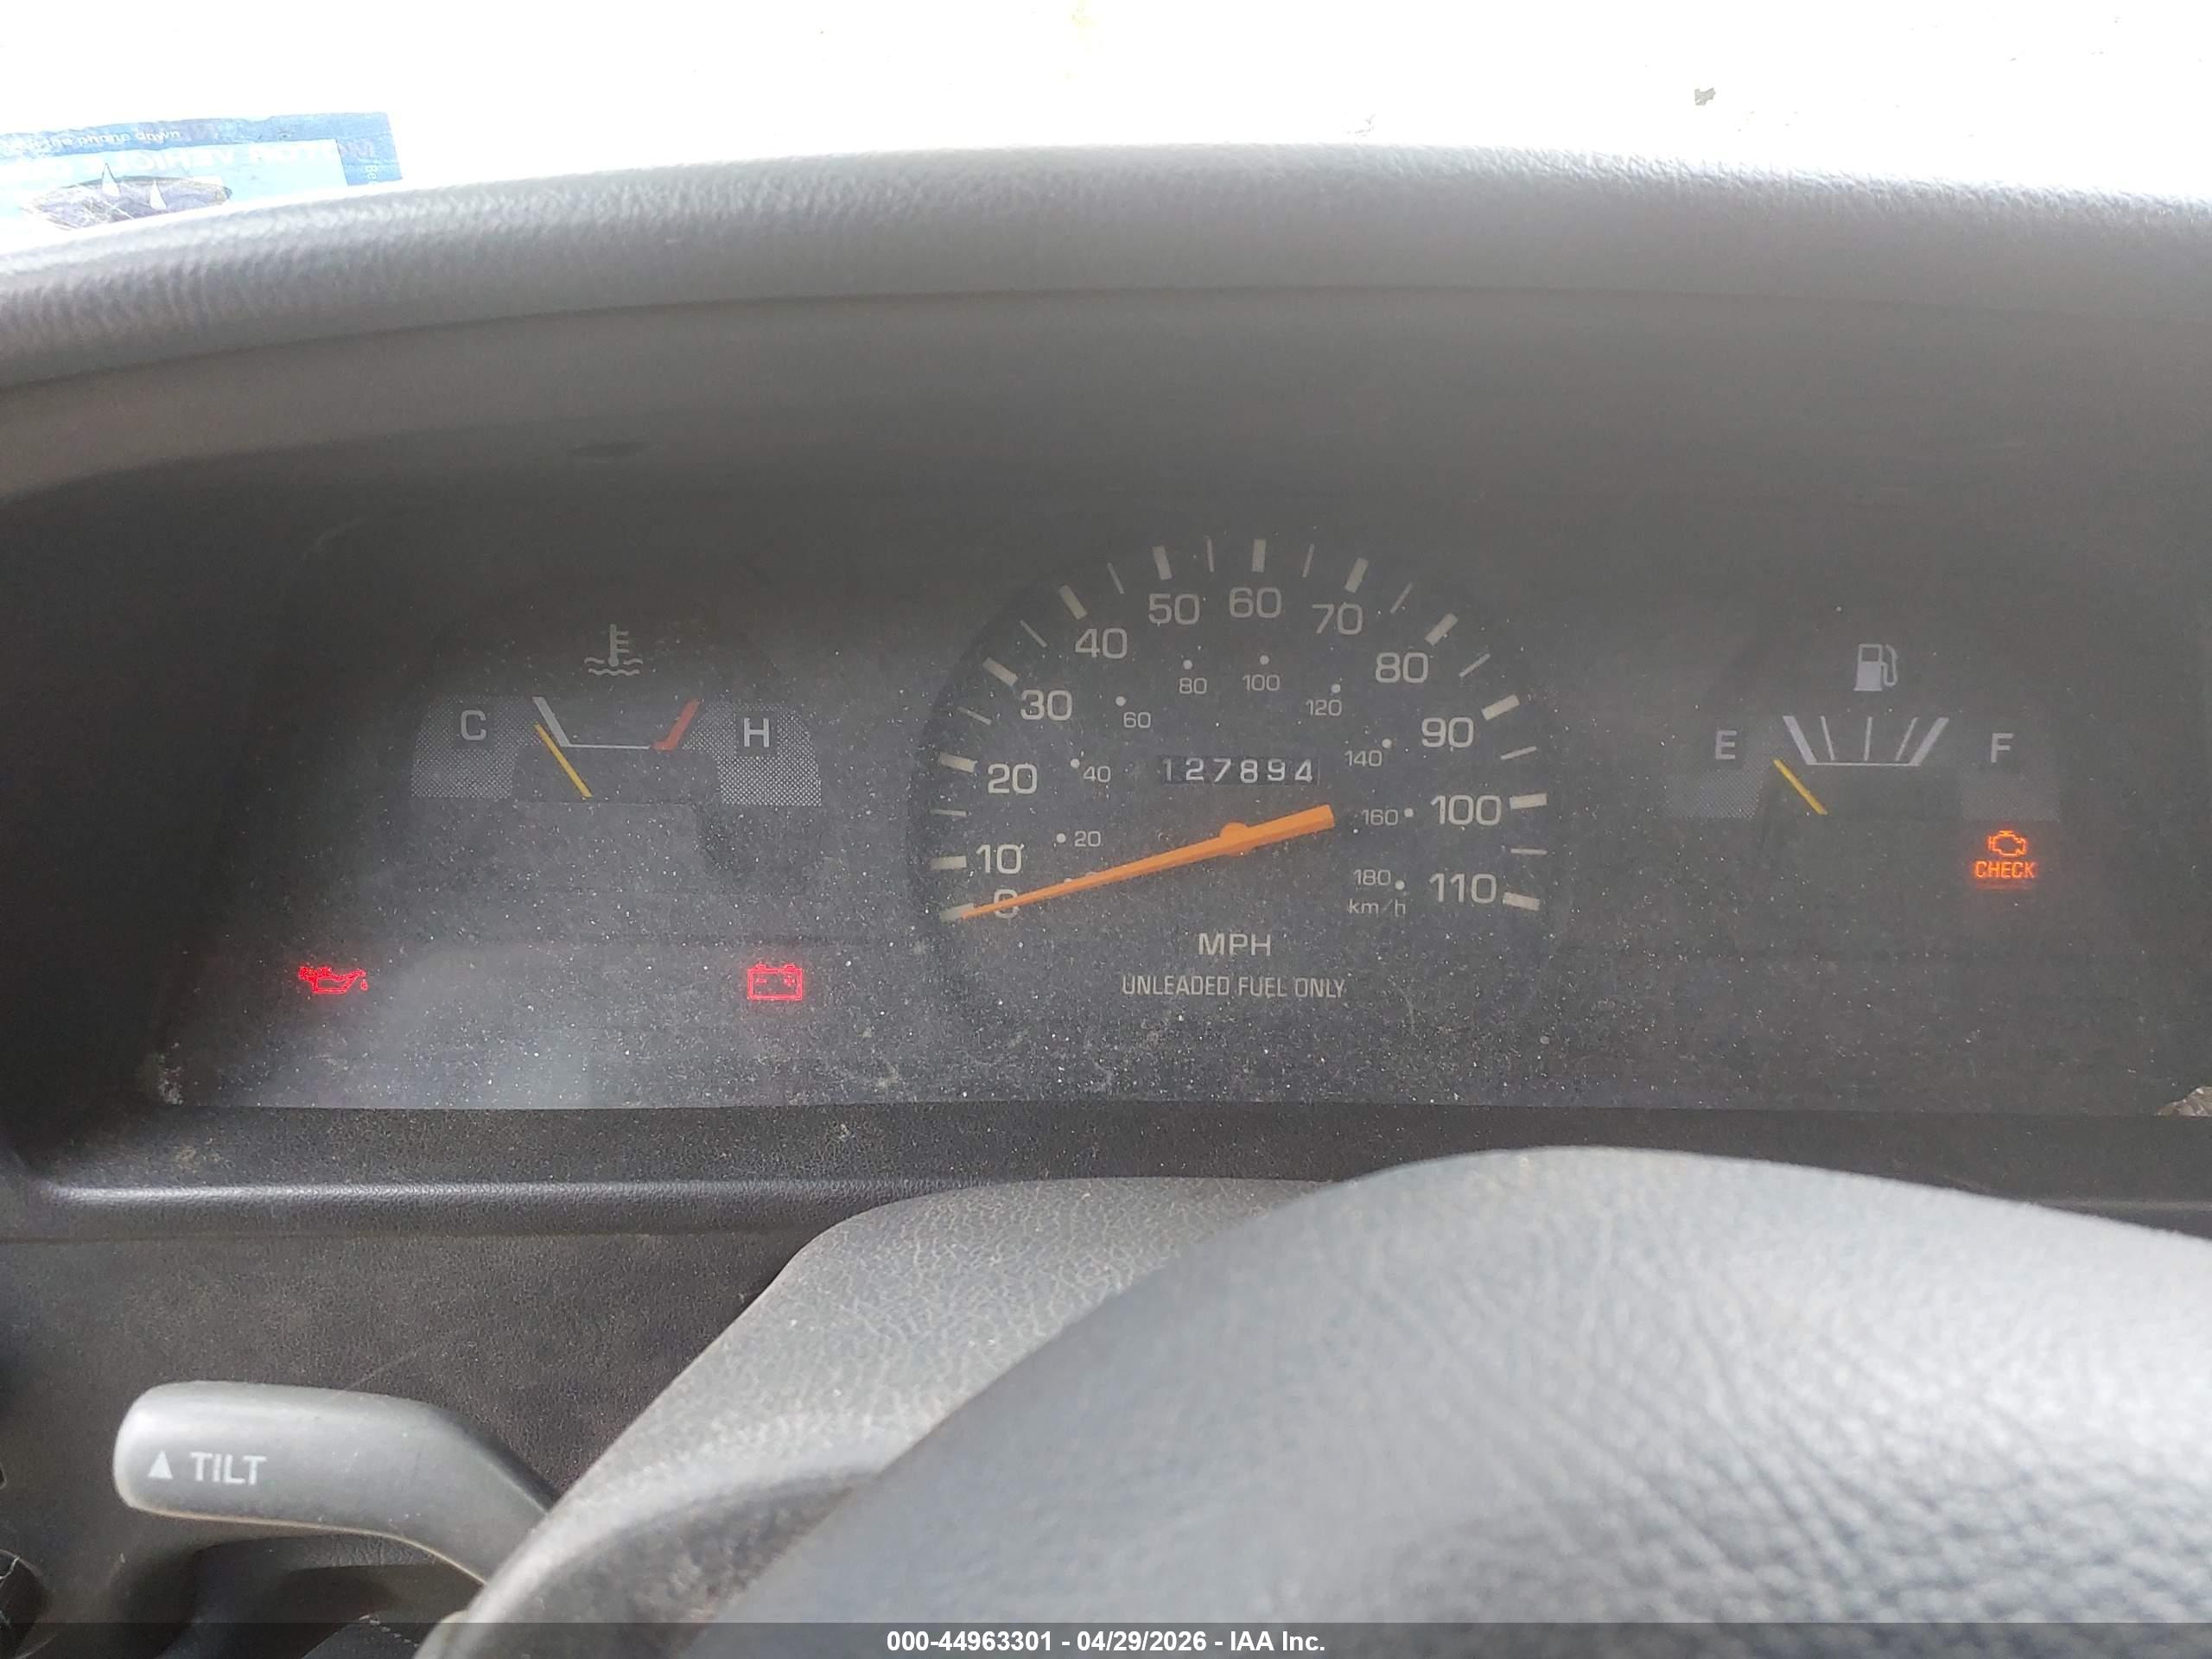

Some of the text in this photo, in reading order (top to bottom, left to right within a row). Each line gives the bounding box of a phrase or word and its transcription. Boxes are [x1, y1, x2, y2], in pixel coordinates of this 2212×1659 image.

[78, 131, 131, 146] phone
[1147, 593, 1200, 625] 50
[1229, 587, 1281, 619] 60
[1312, 603, 1363, 635] 70
[1075, 628, 1128, 659] 40
[1242, 674, 1281, 691] 100
[1376, 652, 1428, 683] 80
[1179, 677, 1207, 695] 80
[1020, 690, 1072, 721] 30
[1123, 712, 1151, 728] 60
[1306, 699, 1342, 716] 120
[460, 709, 486, 741] C
[743, 717, 770, 747] H
[1421, 717, 1474, 747] 90
[1344, 750, 1382, 767] 140
[1714, 730, 1738, 760] E
[1991, 733, 2014, 764] F
[988, 764, 1038, 794] 20
[1083, 766, 1111, 783] 40
[1162, 757, 1313, 784] 127894
[1363, 809, 1398, 826] 160
[1431, 795, 1502, 825] 100
[1074, 830, 1102, 848] 20
[976, 844, 1022, 874] 10
[1974, 861, 2035, 879] CHECK
[1353, 869, 1391, 887] 180
[1429, 874, 1497, 904] 110
[994, 889, 1020, 919] 0
[1347, 899, 1406, 915] km/h
[1198, 932, 1271, 956] MPH
[1122, 975, 1345, 999] UNLEADED FUEL ONLY
[191, 1452, 266, 1485] TILT
